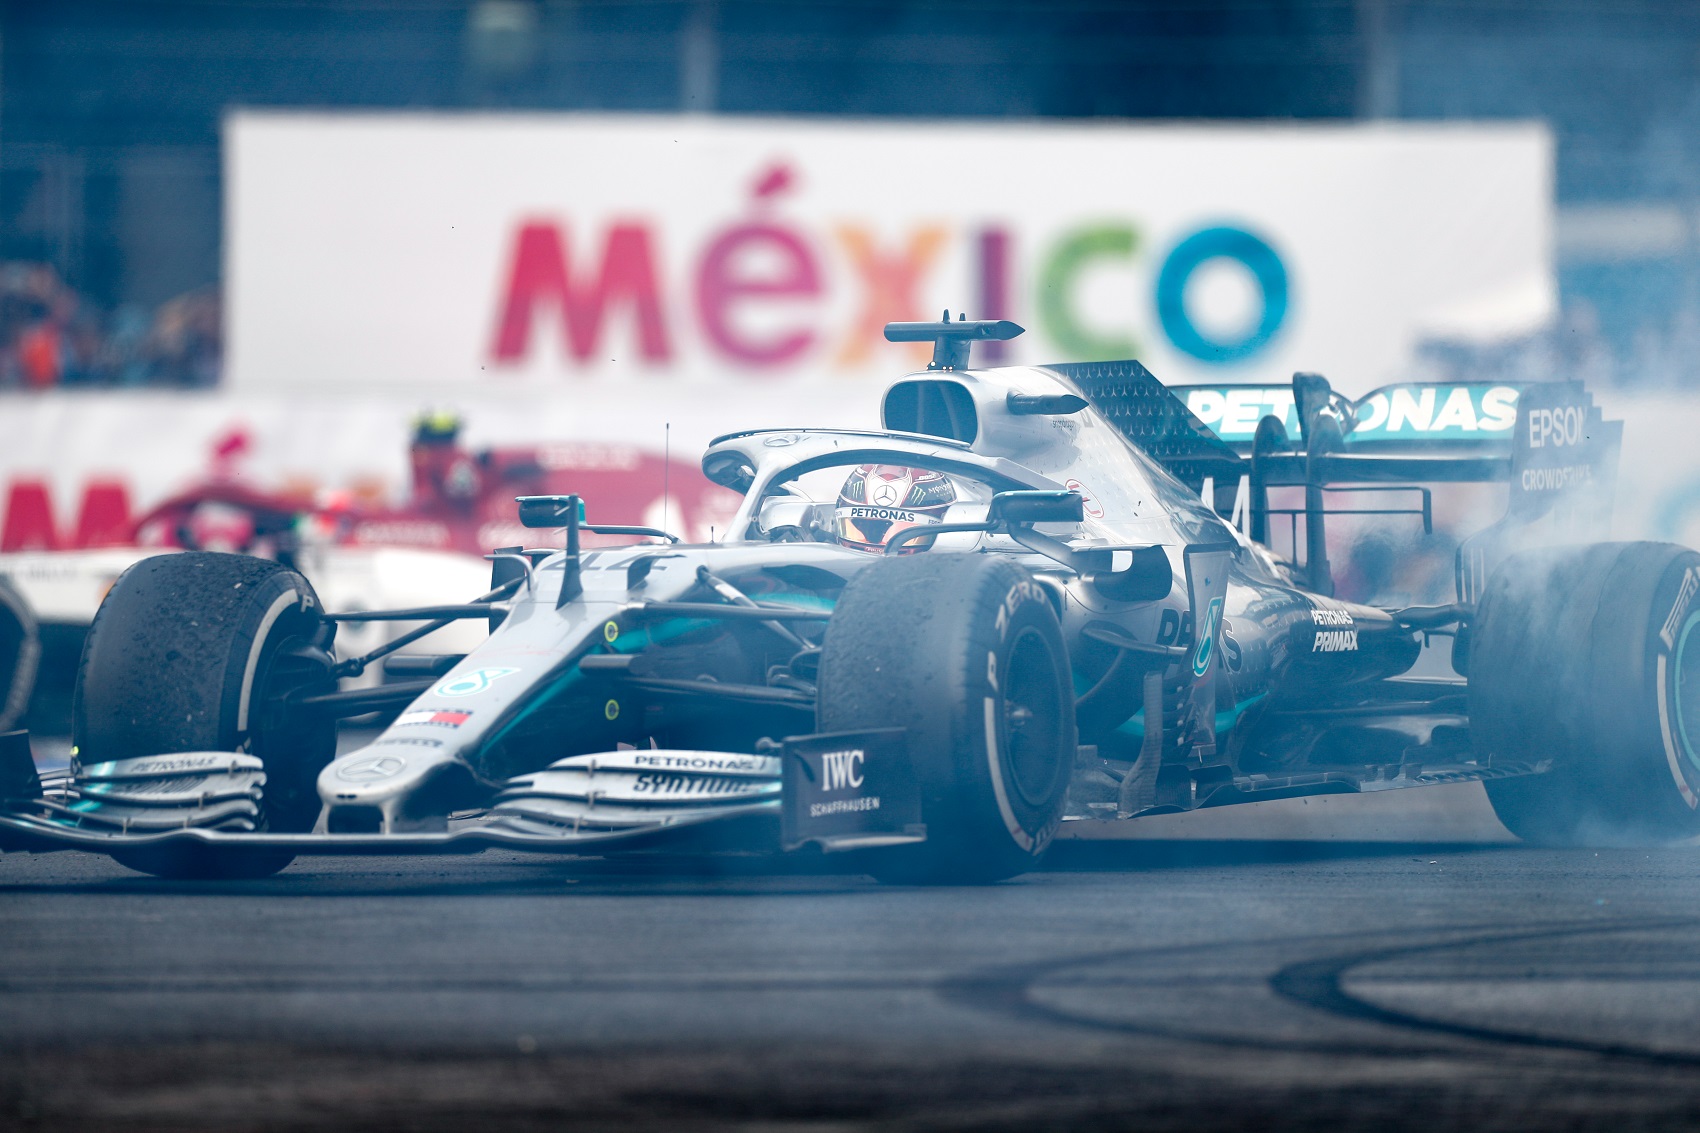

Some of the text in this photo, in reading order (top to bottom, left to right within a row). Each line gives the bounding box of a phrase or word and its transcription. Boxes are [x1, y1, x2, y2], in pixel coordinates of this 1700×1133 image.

[1188, 387, 1519, 433] PETONAS
[850, 508, 915, 523] PETRONAS
[1311, 610, 1354, 626] PETRONAS
[1312, 630, 1359, 652] PRIMAX
[131, 755, 218, 773] PETRONAS
[634, 755, 753, 770] PETRONAS
[822, 749, 865, 791] IWC
